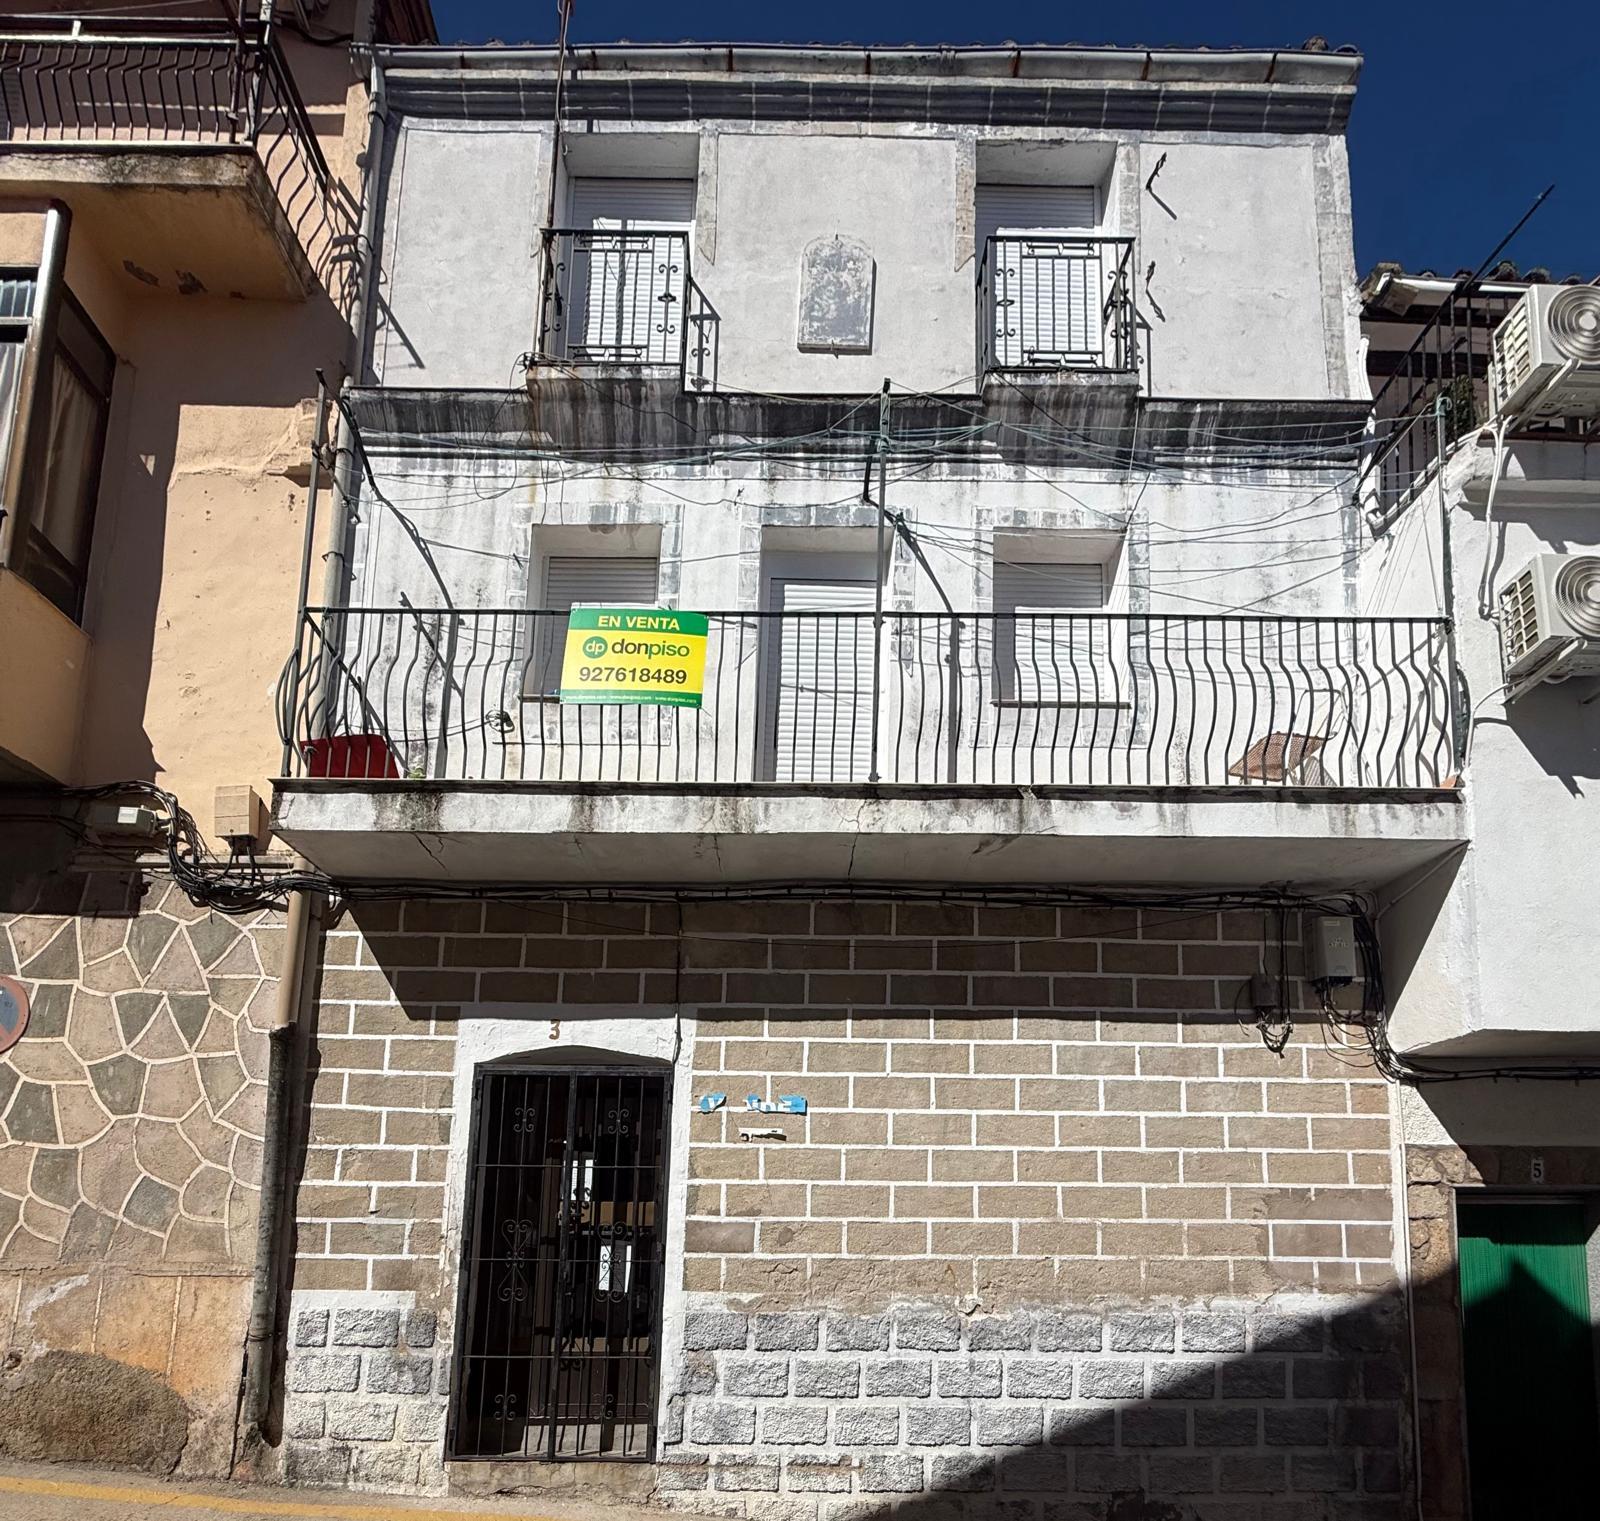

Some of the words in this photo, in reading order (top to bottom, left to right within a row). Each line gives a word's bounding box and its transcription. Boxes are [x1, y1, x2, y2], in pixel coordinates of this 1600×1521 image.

[597, 615, 621, 628] EN
[626, 616, 680, 631] VENTA
[585, 640, 605, 655] dp
[611, 638, 690, 659] donpiso
[579, 666, 687, 684] 927618489
[548, 1018, 561, 1040] 3
[1533, 1162, 1542, 1178] 5
